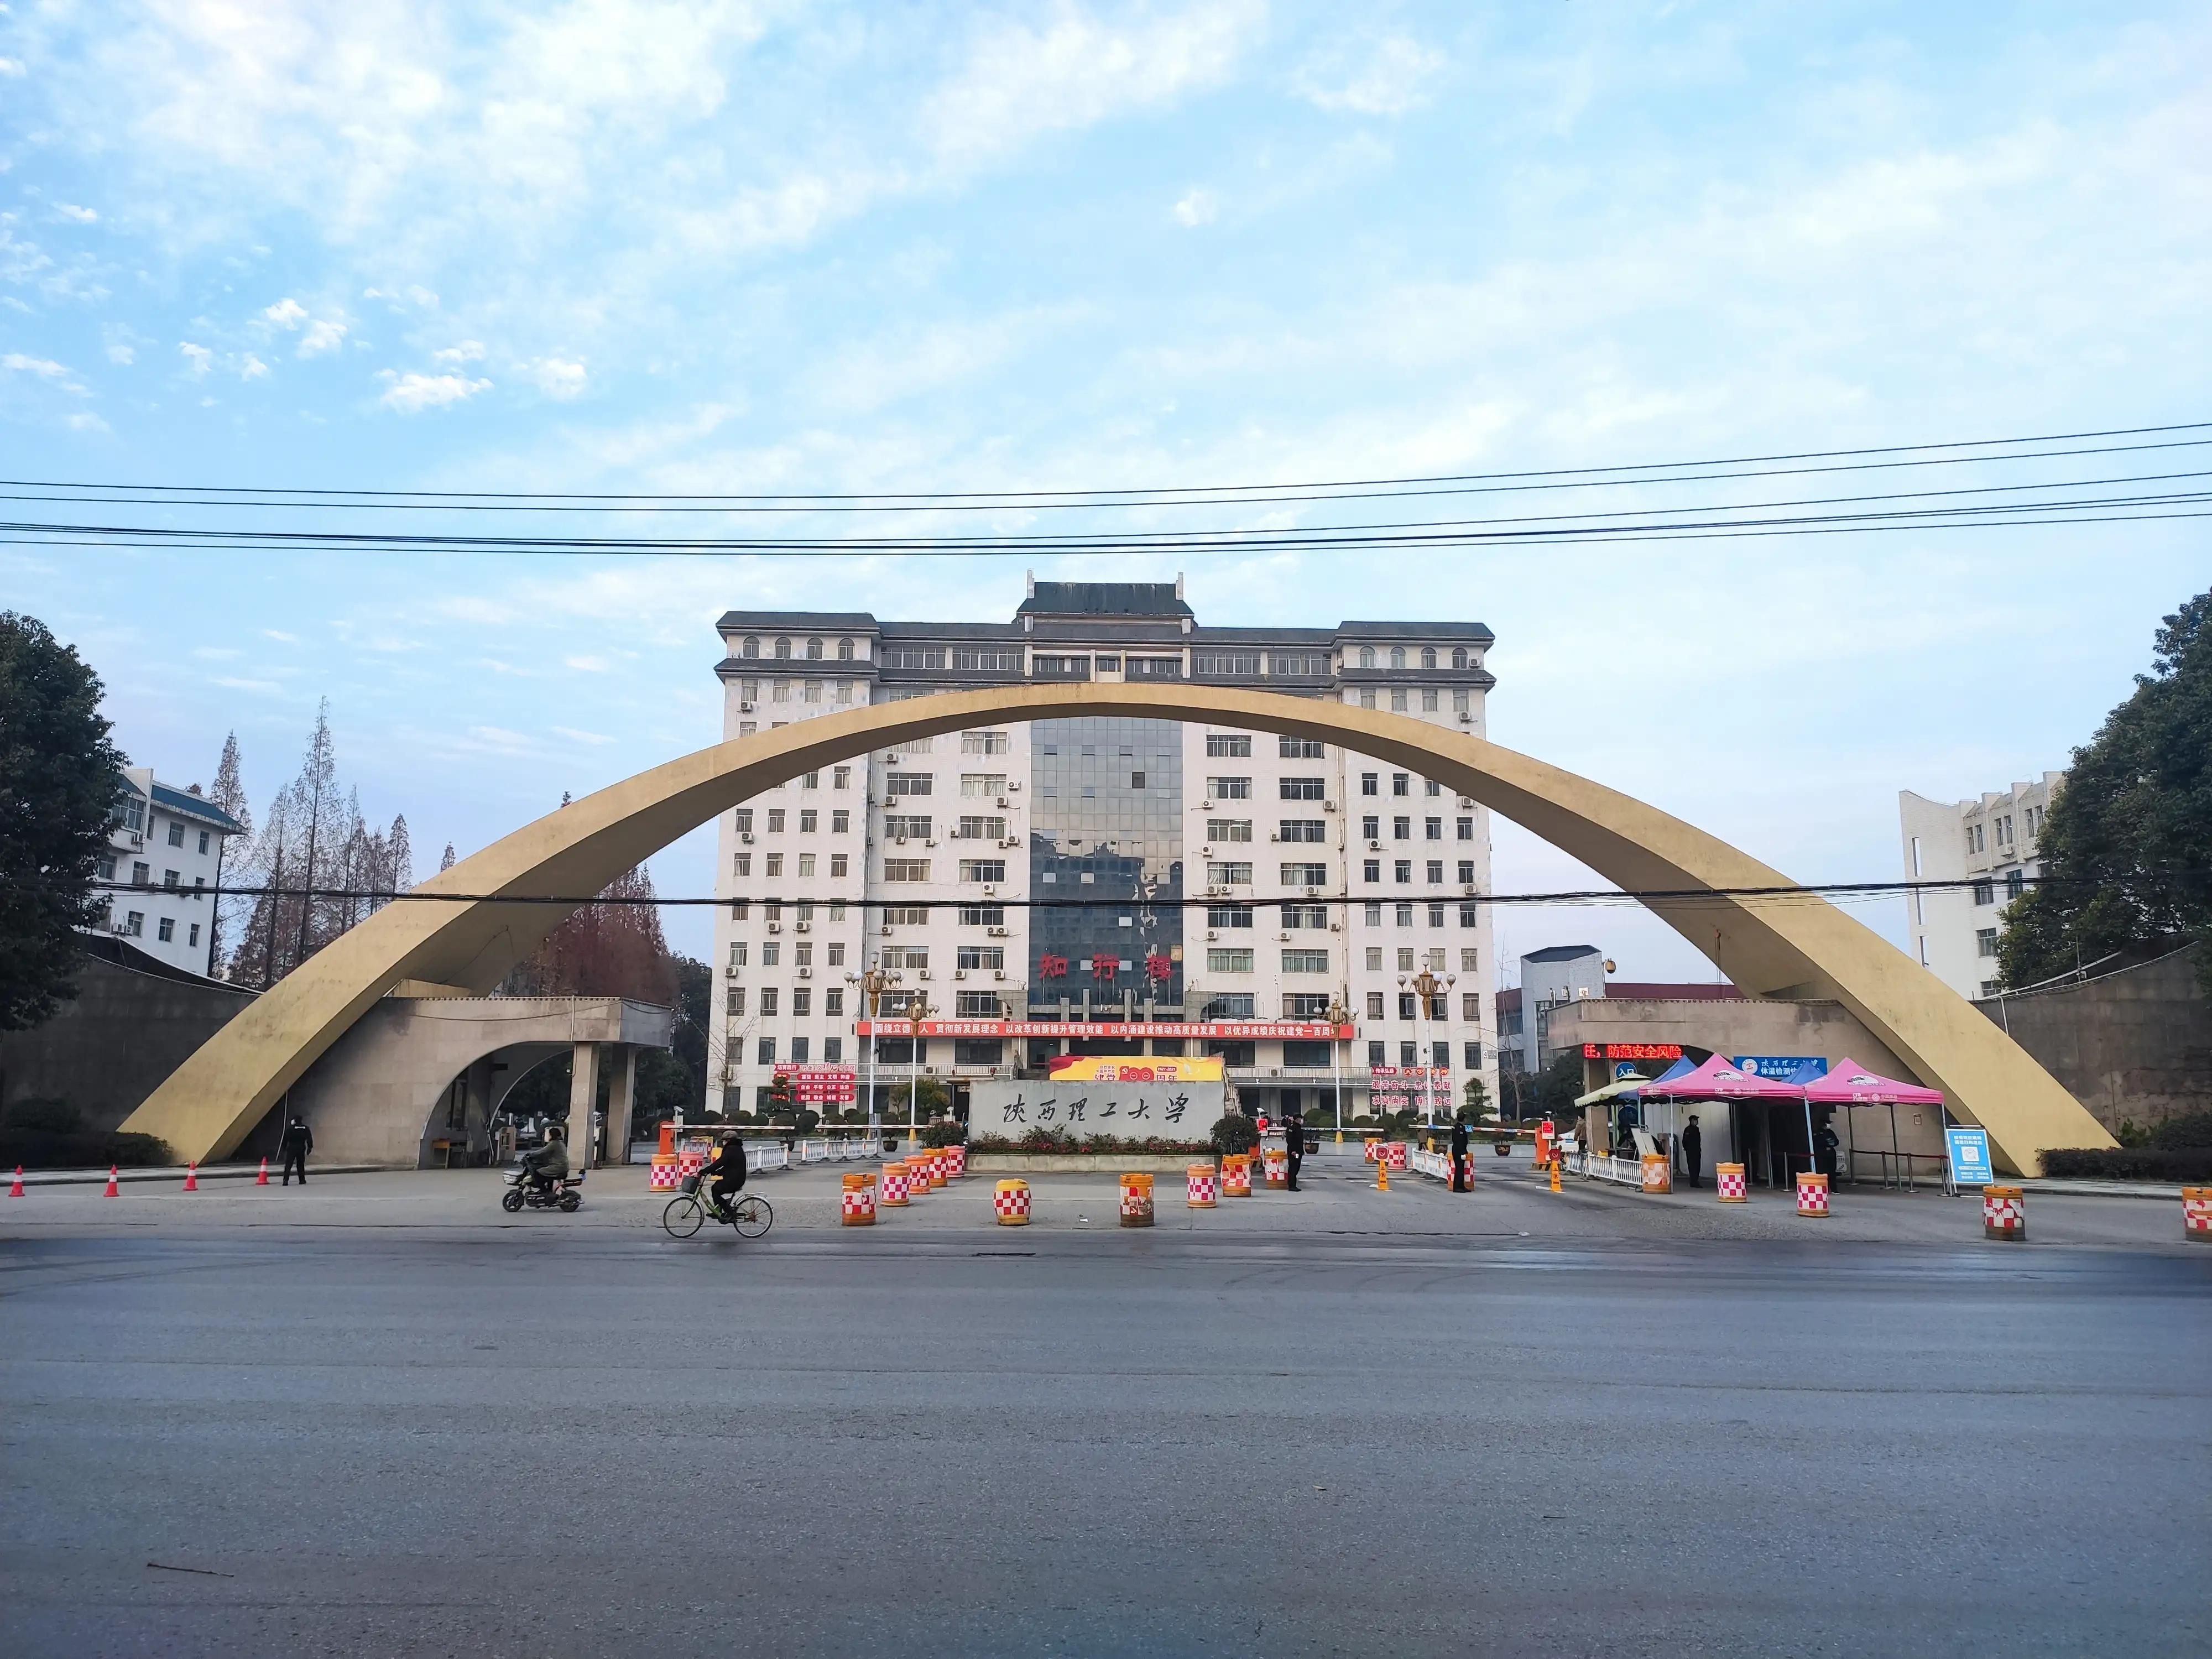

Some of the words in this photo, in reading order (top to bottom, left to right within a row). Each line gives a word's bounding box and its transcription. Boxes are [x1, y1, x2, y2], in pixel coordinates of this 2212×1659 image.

[875, 1024, 928, 1034] 围绕立德人
[935, 1024, 999, 1034] 贯彻新发展理念
[1005, 1024, 1104, 1035] 以改革创新提升管理效能
[1110, 1025, 1217, 1036] 以内涵建设推动高质量发展
[1372, 1080, 1407, 1089] 艰苦奋斗
[1372, 1095, 1408, 1105] 求真尚实
